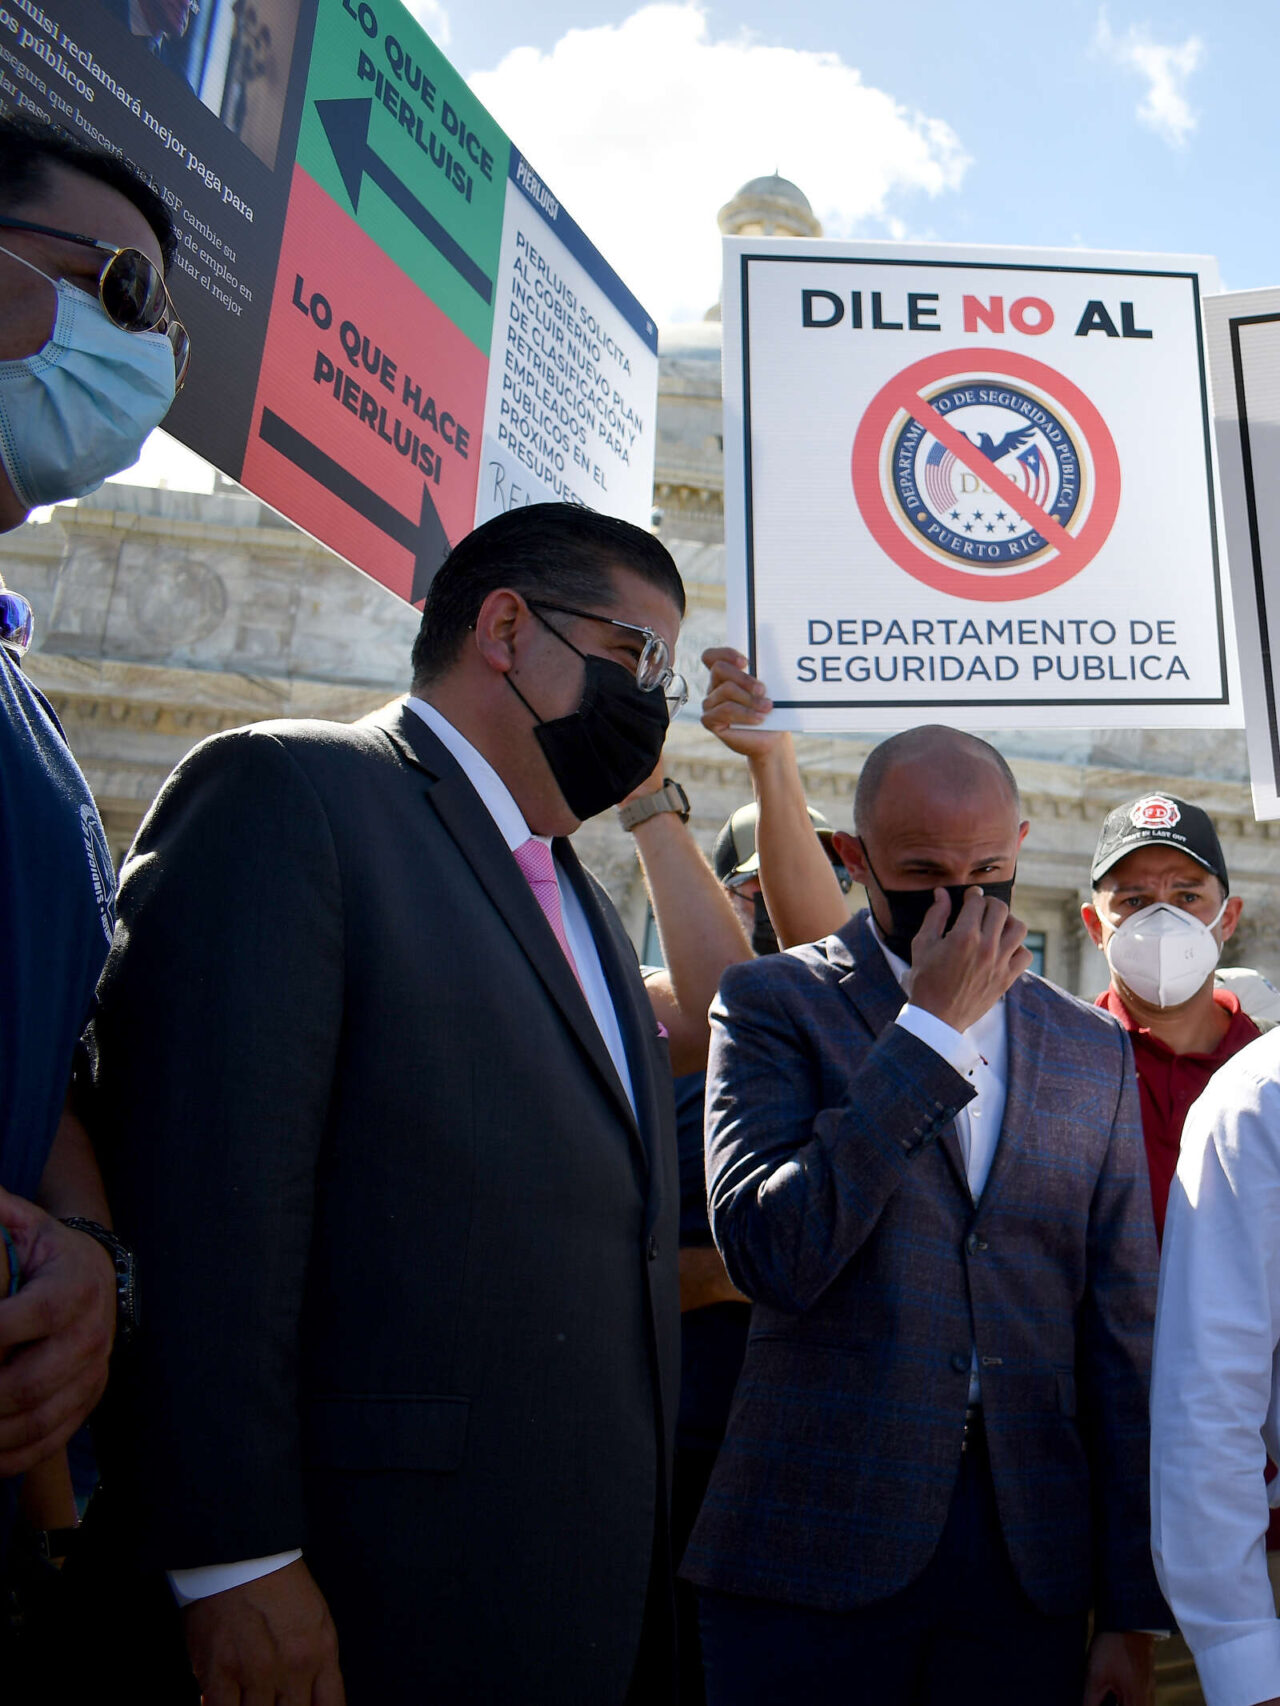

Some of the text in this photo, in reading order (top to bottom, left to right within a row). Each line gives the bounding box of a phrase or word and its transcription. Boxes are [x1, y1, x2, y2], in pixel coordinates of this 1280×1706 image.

[20, 27, 95, 103] públicos
[342, 0, 494, 182] LO QUE DICE
[48, 89, 73, 118] que
[183, 209, 222, 250] cambie
[223, 245, 236, 264] su
[60, 33, 141, 118] reclamará
[144, 111, 187, 158] mejor
[187, 152, 222, 192] paga
[222, 186, 254, 222] para
[357, 48, 473, 204] PIERLUISI
[516, 161, 559, 220] PIERLUISI
[184, 234, 252, 302] de empleo en
[201, 275, 211, 290] el
[212, 287, 243, 317] mejor
[513, 257, 600, 362] AL GOBIERNO
[516, 230, 632, 377] PIERLUISI SOLICITA
[801, 289, 1154, 339] DILE NO AL
[292, 274, 470, 460] LO QUE HACE
[505, 349, 586, 445] EMPLEADOS
[507, 325, 629, 467] RETRIBUCIÓN PARA
[509, 301, 636, 447] DE CLASIFICACIÓN Y
[512, 277, 643, 434] INCLUIR NUEVO PLAN
[313, 350, 442, 485] PIERLUISI
[500, 397, 564, 472] PRÓXIMO
[503, 373, 608, 492] PÚBLICOS EN EL
[953, 390, 977, 405] DE
[979, 390, 1063, 443] SEGURIDAD
[1056, 443, 1076, 508] PÚBLICA
[928, 523, 1041, 557] PUERTO RIC
[796, 655, 1191, 682] SEGURIDAD PUBLICA
[807, 619, 1178, 646] DEPARTAMENTO DE
